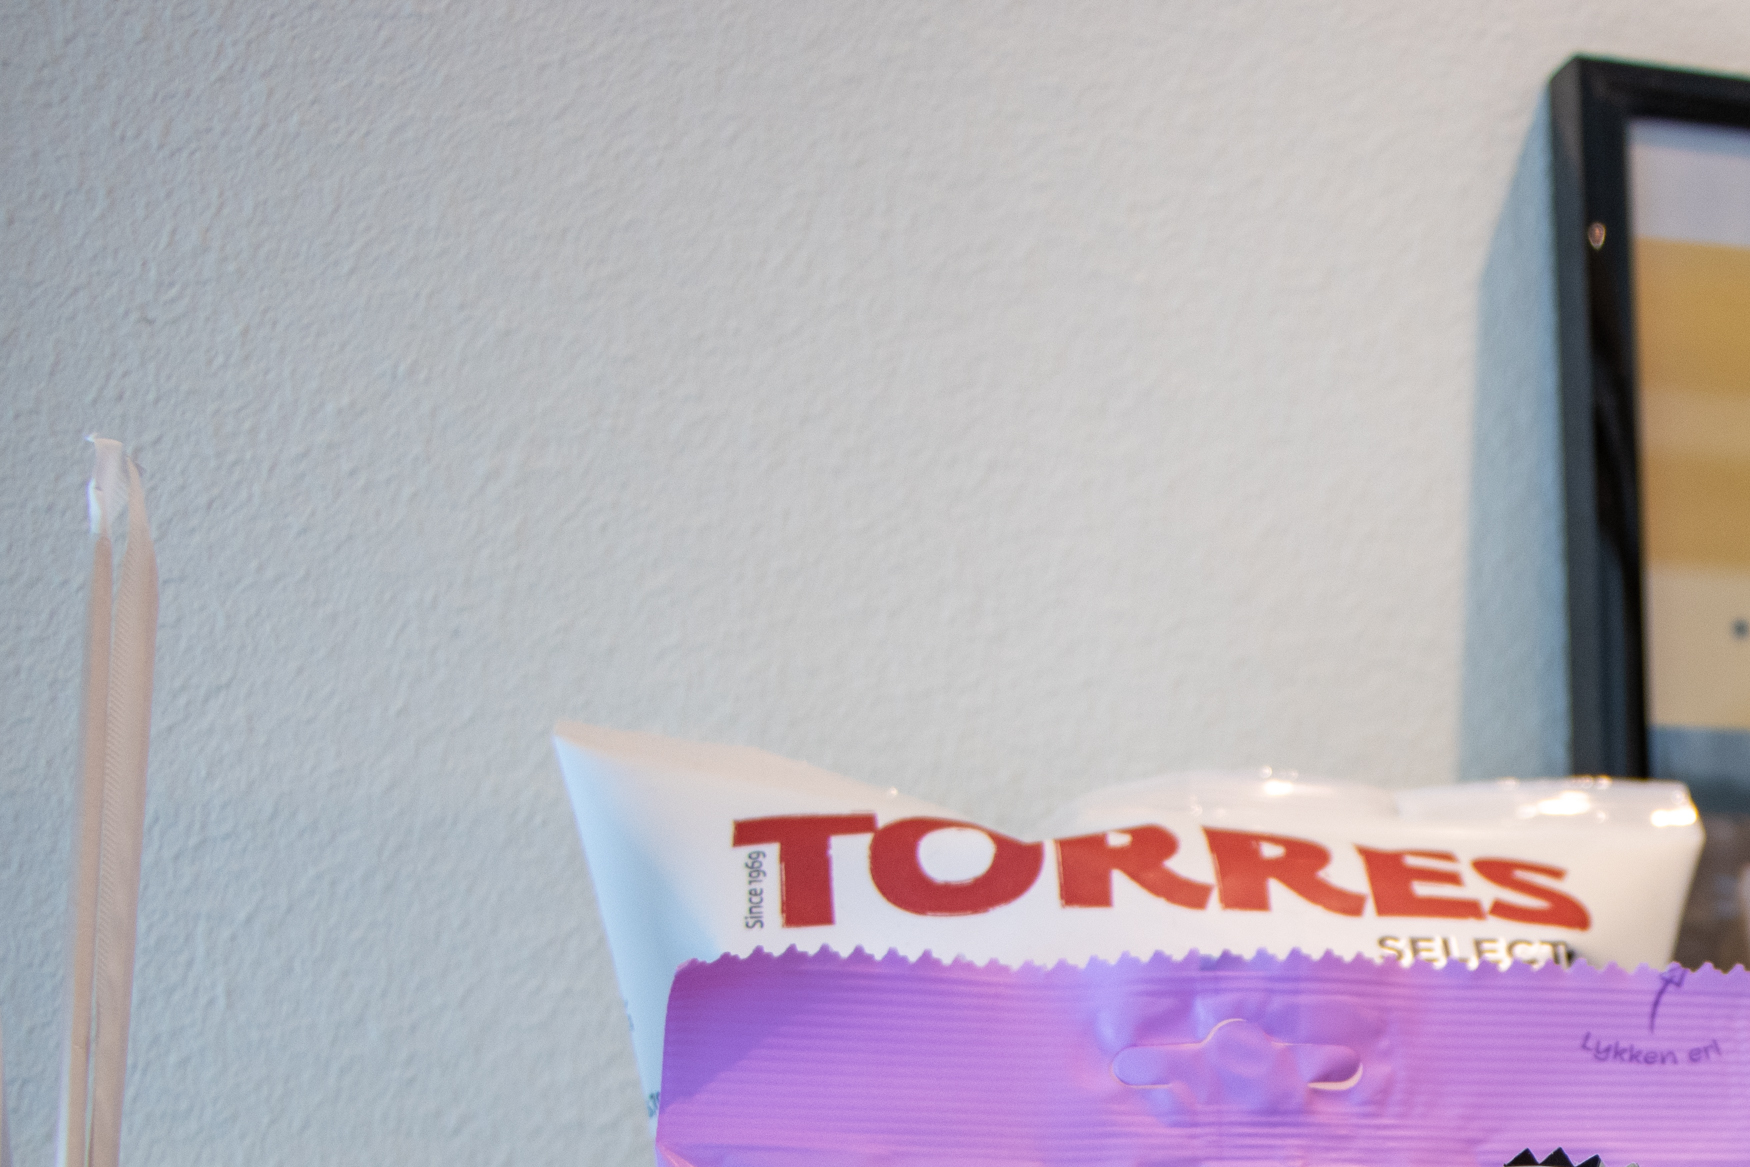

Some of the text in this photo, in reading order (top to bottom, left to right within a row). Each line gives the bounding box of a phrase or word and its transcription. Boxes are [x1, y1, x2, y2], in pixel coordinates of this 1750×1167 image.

[732, 813, 1593, 931] TORRES
[744, 850, 767, 929] Since 1969
[1581, 1031, 1679, 1066] Lykken
